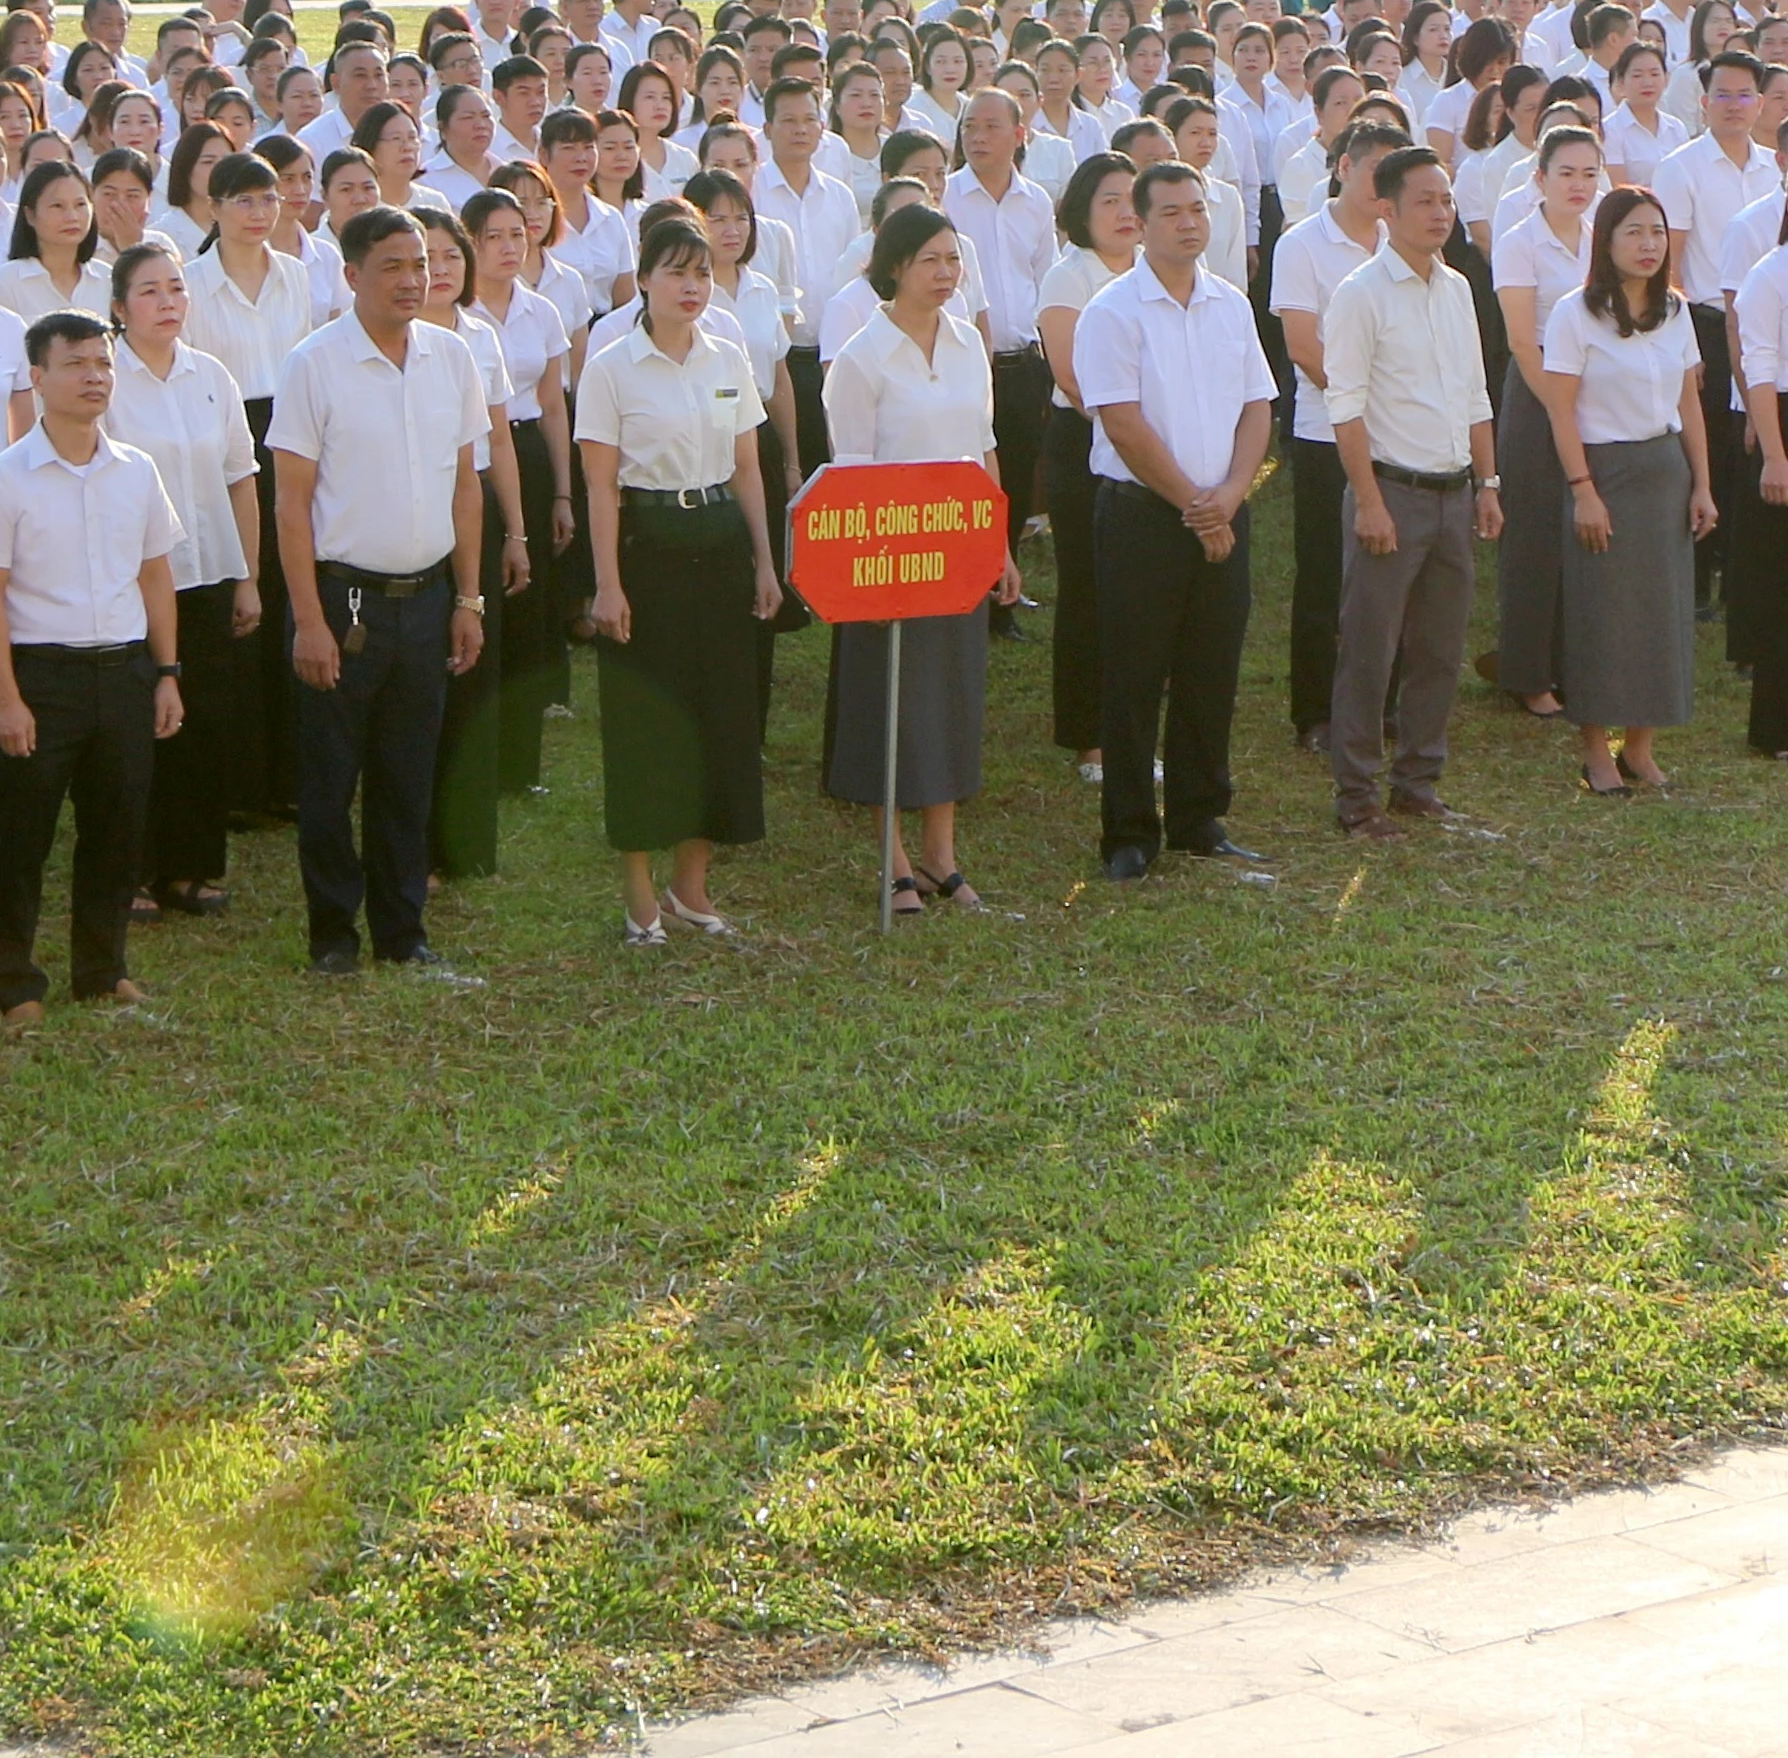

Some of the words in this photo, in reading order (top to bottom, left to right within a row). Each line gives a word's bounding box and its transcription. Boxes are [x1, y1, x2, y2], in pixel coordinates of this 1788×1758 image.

[807, 506, 841, 541] CÁN
[845, 501, 871, 544] BỘ,
[875, 499, 918, 536] CÔNG
[922, 495, 968, 535] CHỨC,
[972, 499, 993, 530] VC
[852, 545, 894, 587] KHỐI
[899, 550, 945, 583] UBND
